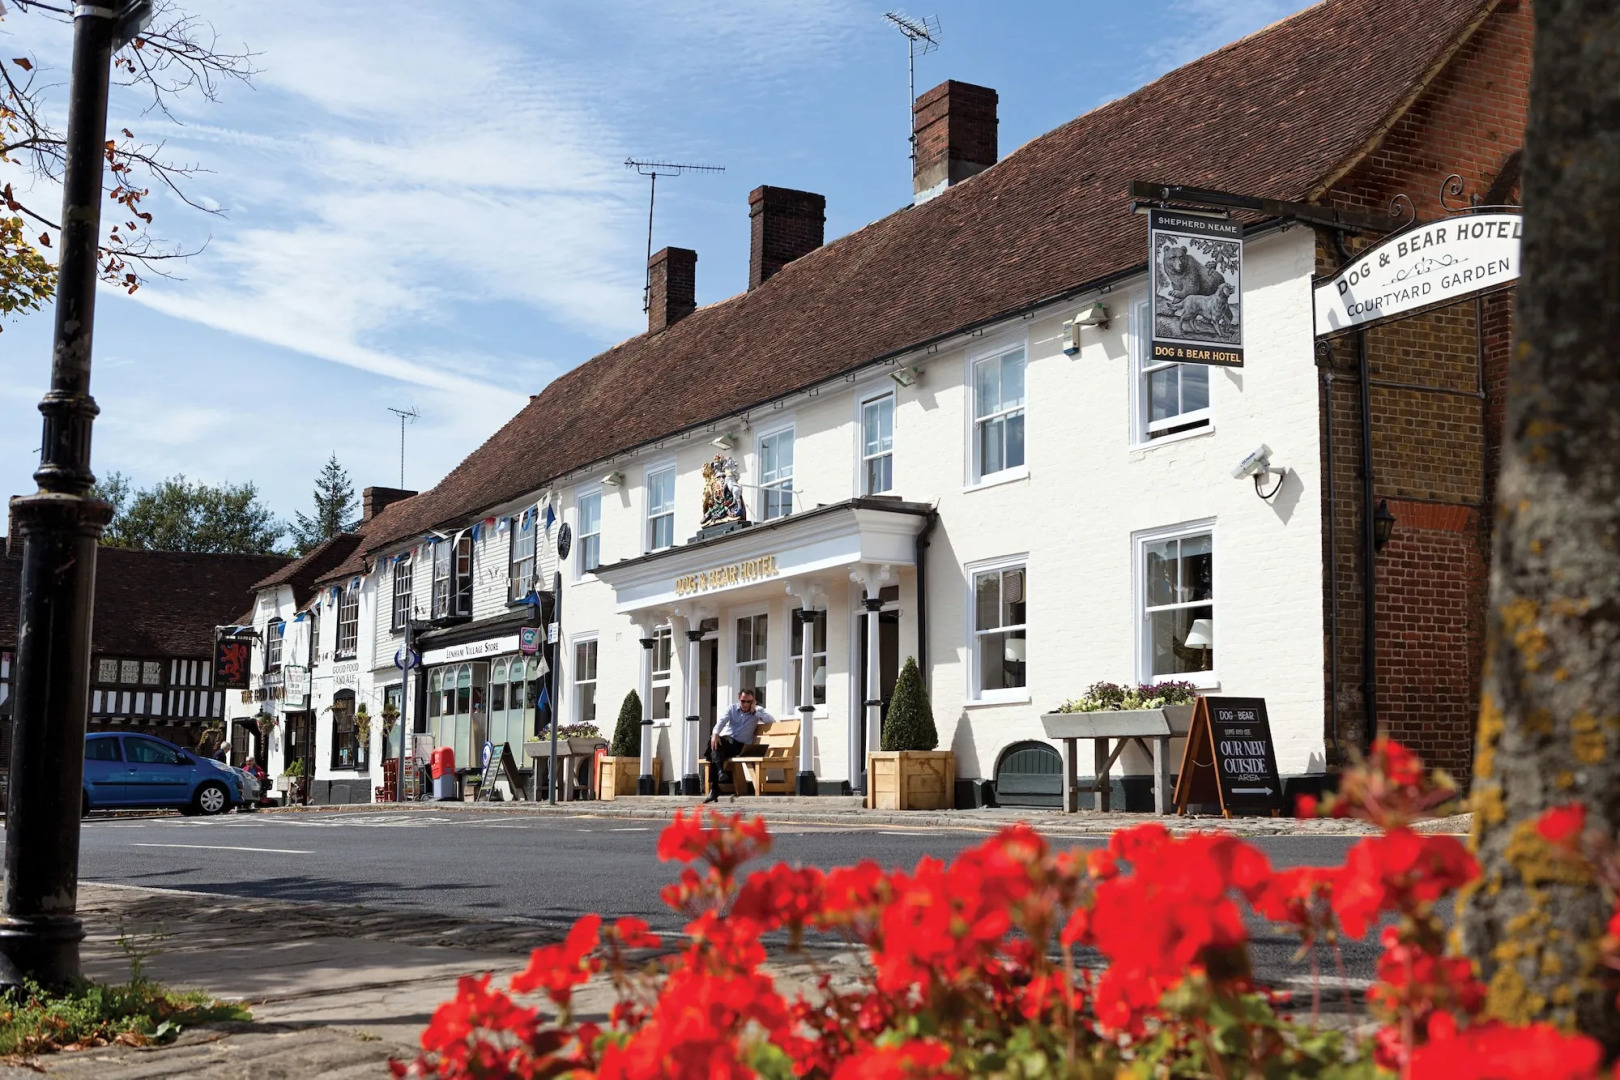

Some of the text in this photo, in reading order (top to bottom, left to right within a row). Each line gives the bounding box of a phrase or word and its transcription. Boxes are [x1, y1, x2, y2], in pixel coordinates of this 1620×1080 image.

[1158, 217, 1238, 234] SHEPHERD NEAME
[1336, 221, 1523, 296] DOG & BEAR HOTEL
[1346, 257, 1510, 317] COURTYARD GARDEN
[1155, 346, 1242, 363] DOG & BEAR HOTEL
[675, 555, 777, 595] DOG & BEAR HOTEL
[446, 642, 499, 659] LENHAM VILLAGE STORE
[332, 662, 360, 674] GOOD FOOD
[1219, 710, 1255, 721] DOG BEAR
[1220, 740, 1267, 756] OUR NEW
[1224, 758, 1268, 774] OUTSIDE
[1238, 774, 1260, 782] AREA
